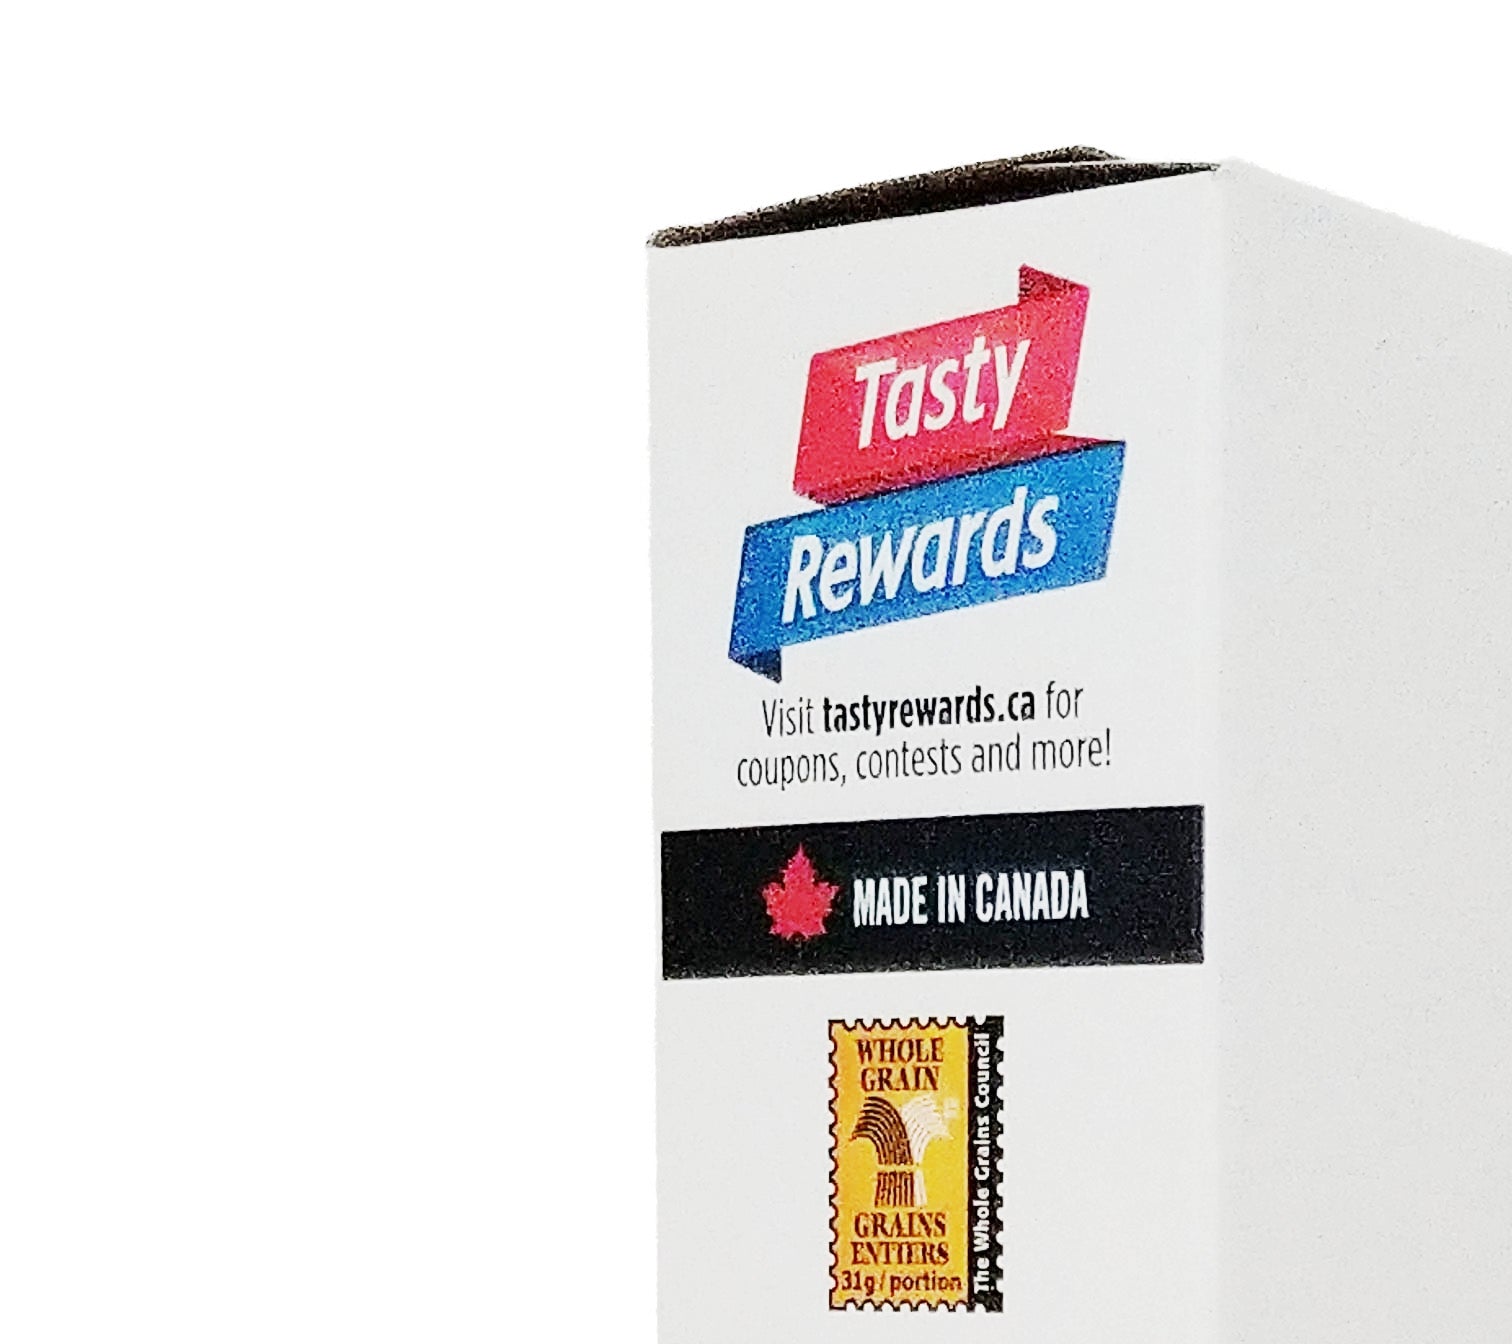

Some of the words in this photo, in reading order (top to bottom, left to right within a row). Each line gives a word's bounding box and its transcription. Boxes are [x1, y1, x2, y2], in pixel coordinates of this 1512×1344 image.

[853, 333, 1032, 450] Tasty
[780, 485, 1060, 625] Rewards
[762, 696, 814, 737] Visit
[822, 685, 1035, 737] tastyrewards.ca
[1046, 680, 1084, 720] for
[737, 752, 846, 792] coupons,
[856, 738, 962, 780] contests
[971, 732, 1021, 773] and
[1032, 727, 1111, 770] more!
[853, 875, 929, 928] MADE
[936, 874, 966, 924] IN
[975, 869, 1090, 923] CANADA
[856, 1037, 944, 1065] WHOLE
[860, 1065, 939, 1093] GRAIN
[973, 1031, 992, 1110] Council
[973, 1114, 991, 1183] Grains
[854, 1212, 946, 1239] GRAINS
[972, 1187, 991, 1254] Whole
[841, 1270, 876, 1297] 31g
[889, 1270, 962, 1298] portion
[973, 1256, 991, 1296] The
